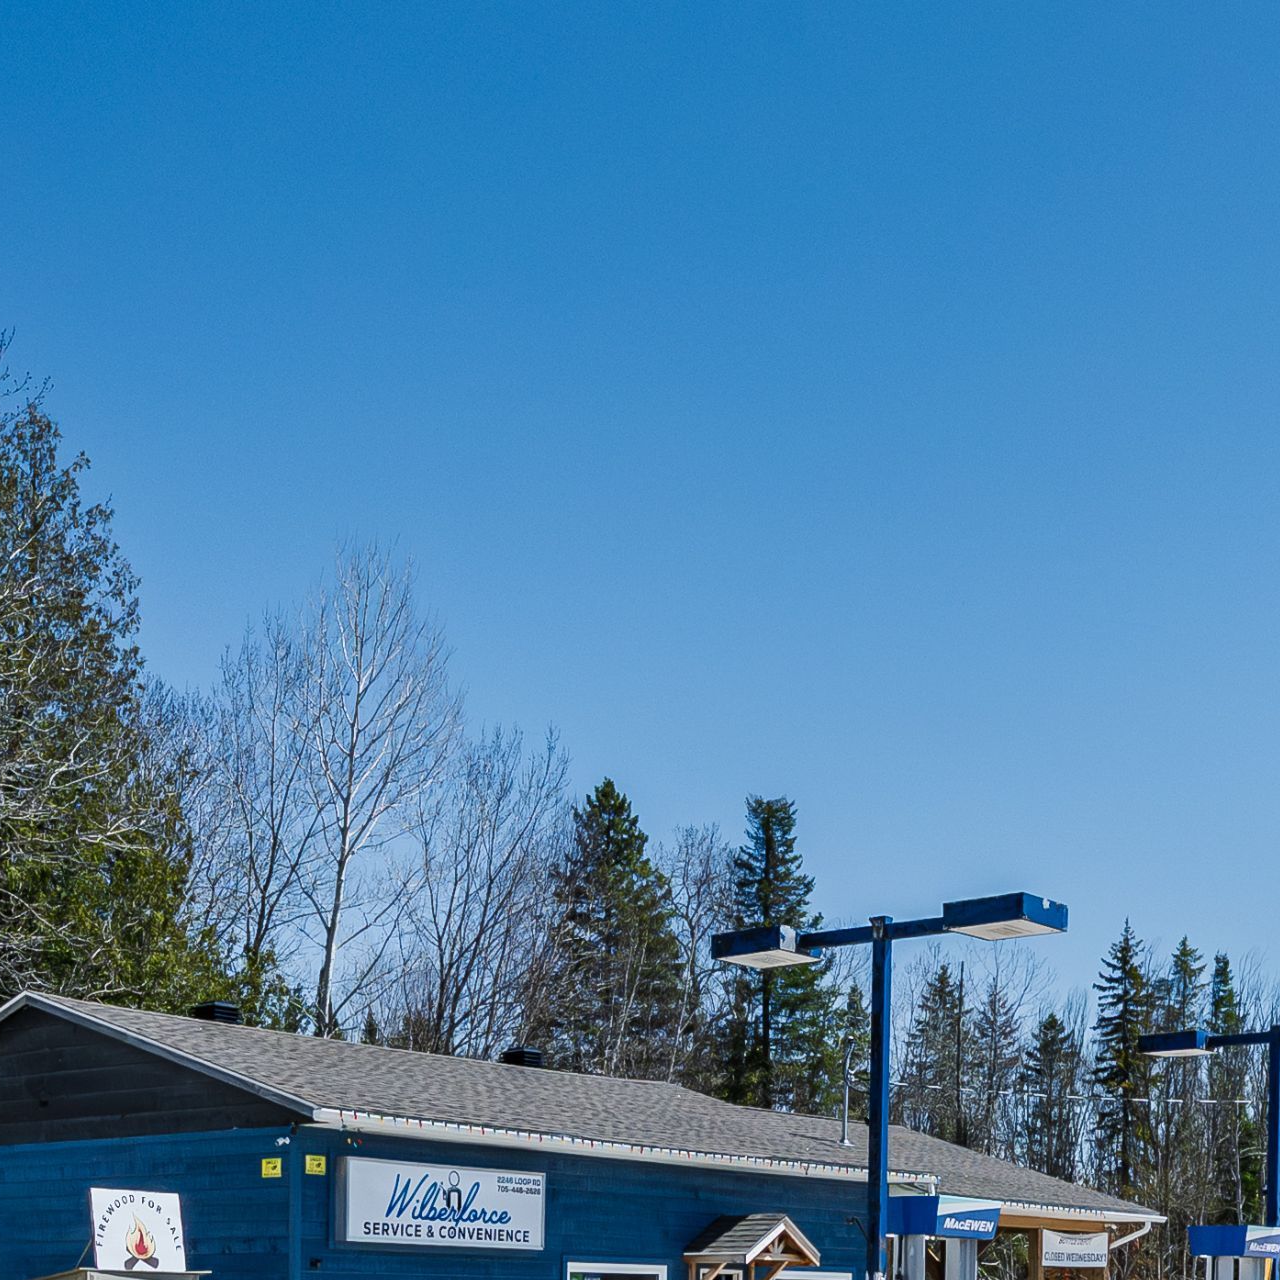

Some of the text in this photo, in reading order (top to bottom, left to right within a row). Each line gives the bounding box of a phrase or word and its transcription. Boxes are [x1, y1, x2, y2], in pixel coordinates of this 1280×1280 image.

[95, 1194, 182, 1252] FIREWOOD FOR SALE
[384, 1173, 512, 1227] Wilberforce
[363, 1221, 530, 1243] SERVICE & CONVENIENCE
